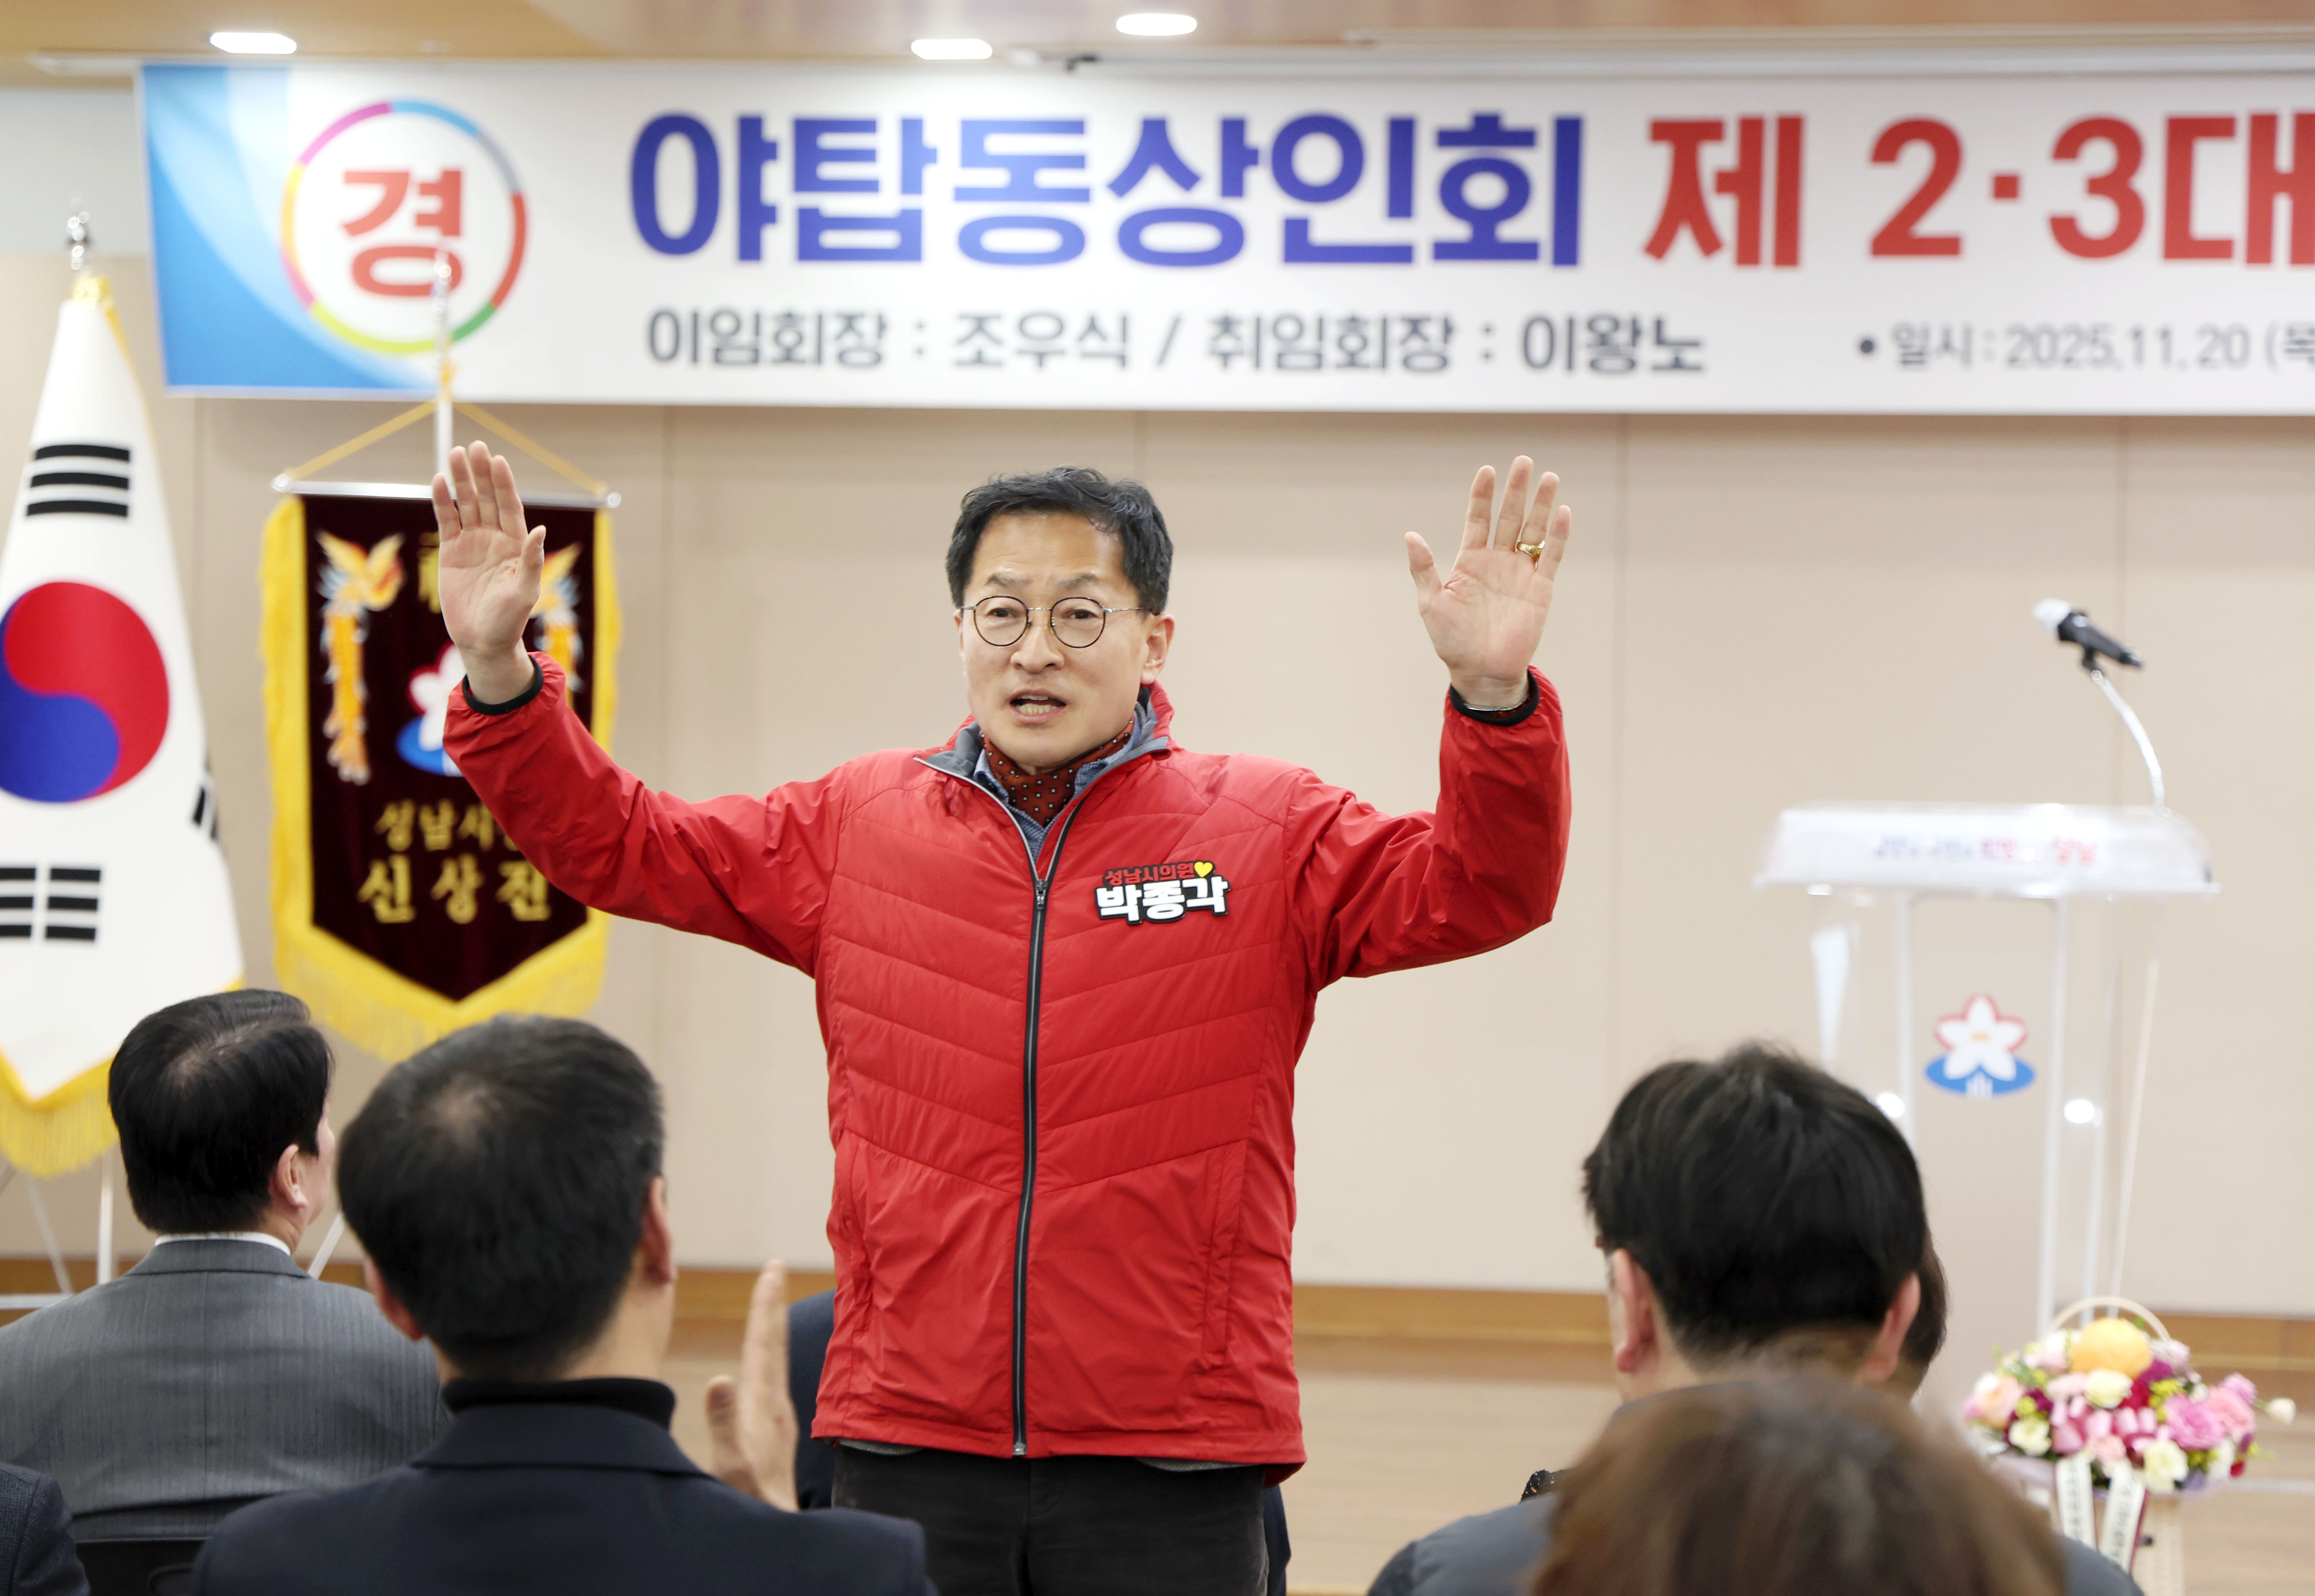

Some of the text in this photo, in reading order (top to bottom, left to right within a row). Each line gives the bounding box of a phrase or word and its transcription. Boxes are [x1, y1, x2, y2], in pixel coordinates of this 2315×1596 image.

[631, 113, 1582, 268] 야탑동상인회
[1644, 115, 1803, 268] 제
[341, 169, 464, 298] 경
[646, 307, 889, 370] 이임회장
[954, 310, 1130, 371] 조우식
[1209, 312, 1457, 375] 취임회장
[1519, 313, 1706, 376] 이왕노
[376, 800, 518, 851] 성남시
[1096, 876, 1228, 922] 박종각
[1105, 863, 1195, 886] 성남시의원
